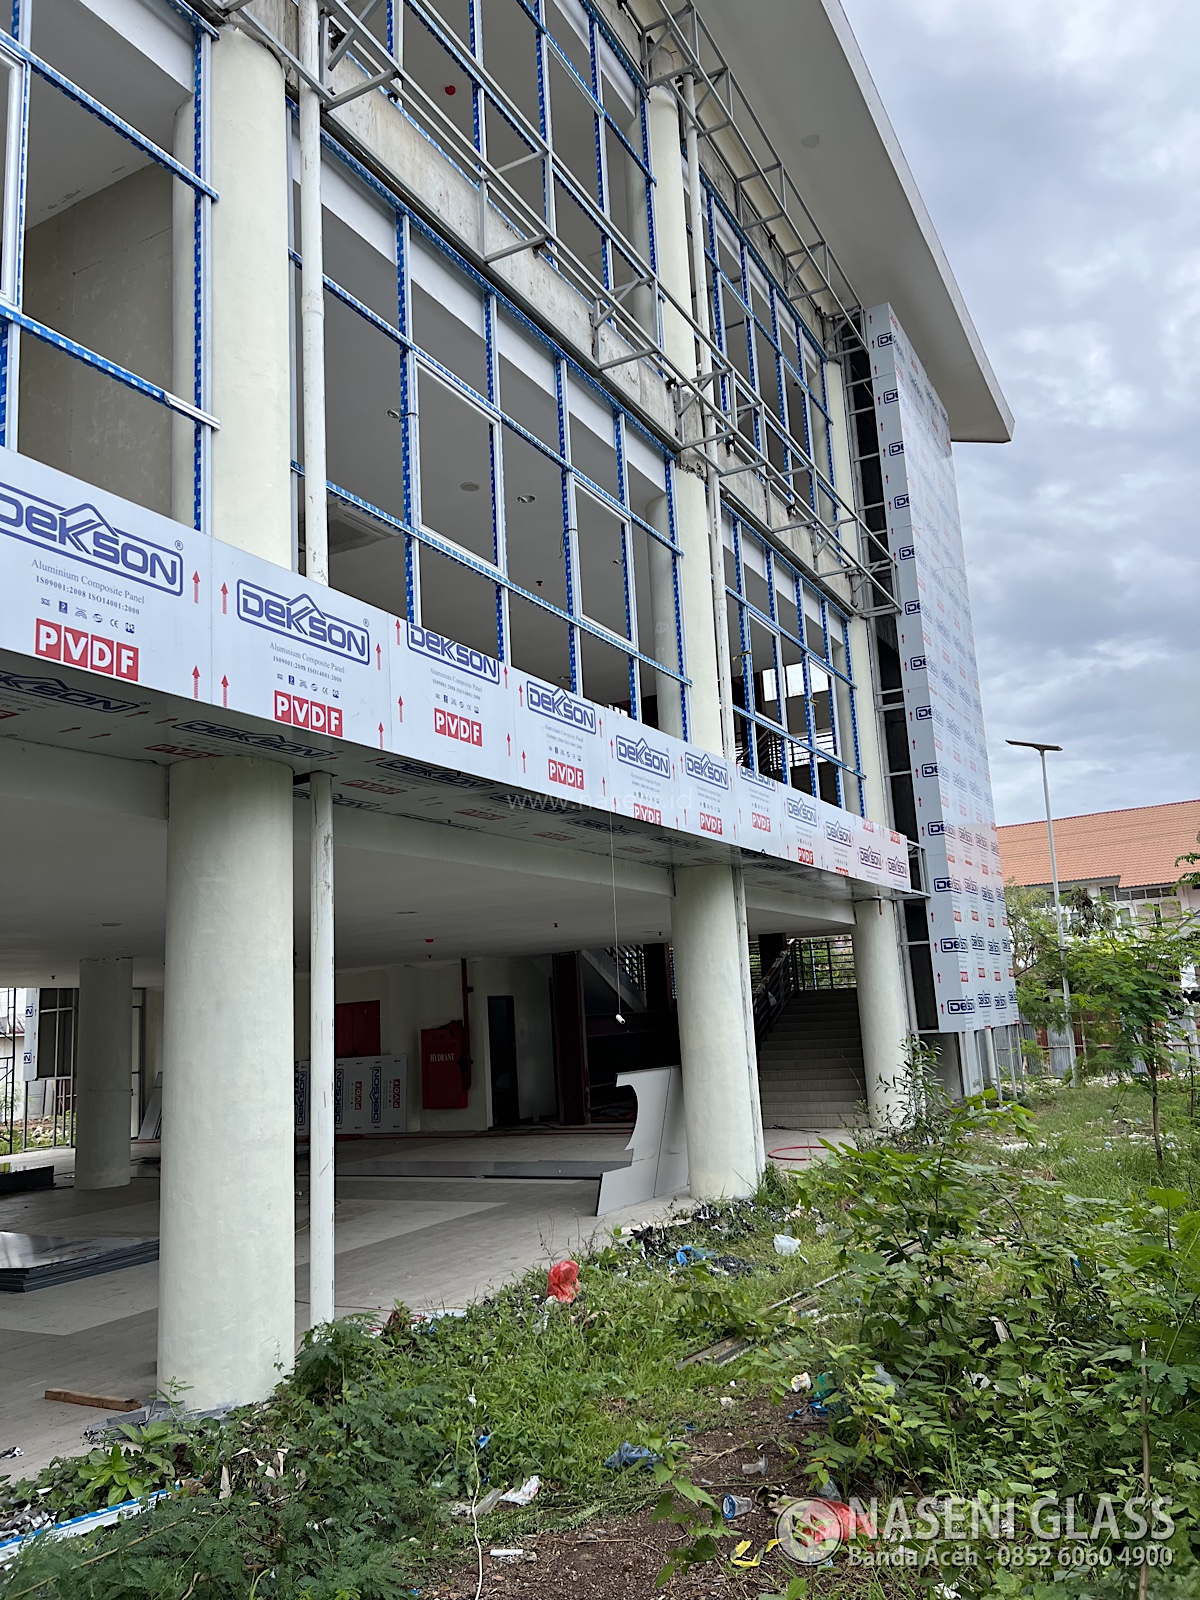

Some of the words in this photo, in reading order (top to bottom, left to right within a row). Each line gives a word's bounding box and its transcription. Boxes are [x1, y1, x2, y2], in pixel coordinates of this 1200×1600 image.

[31, 558, 79, 582] Aluminium
[81, 576, 123, 596] Composite
[124, 590, 145, 604] Panel
[38, 624, 135, 675] PVDF
[302, 653, 331, 668] Composite
[331, 662, 345, 674] Panel
[276, 695, 340, 735] PVDF
[435, 711, 481, 743] PVDF
[151, 744, 223, 758] PVD
[549, 760, 584, 789] PVDF
[634, 804, 662, 826] PVDF
[701, 813, 722, 835] PVDF
[752, 812, 771, 832] PVDF
[430, 1052, 455, 1063] HYDRANT
